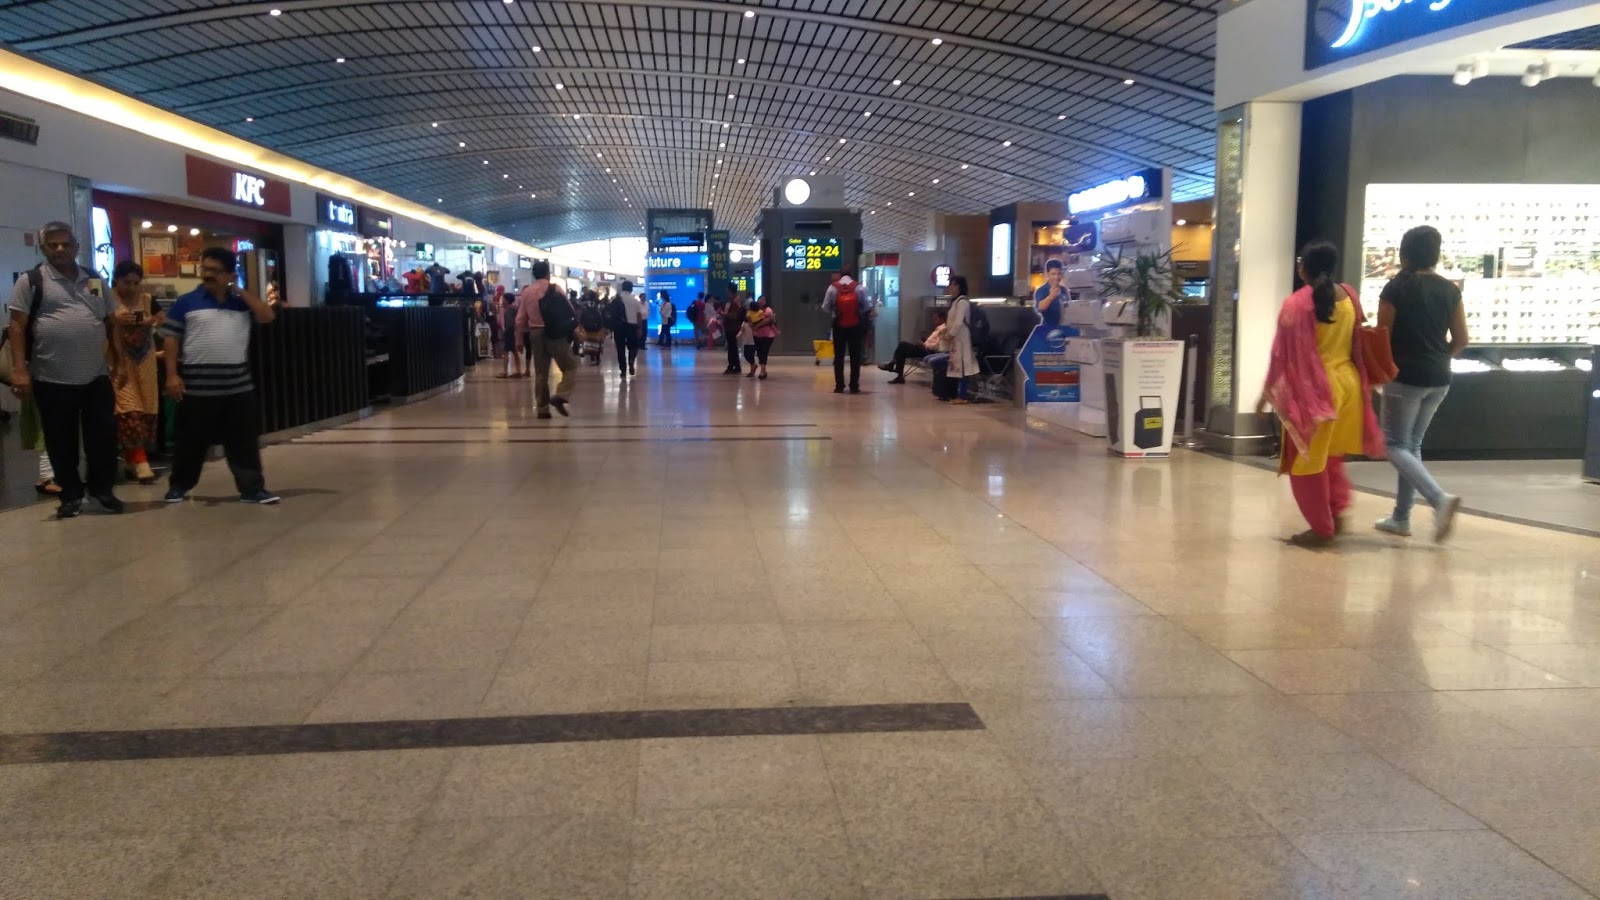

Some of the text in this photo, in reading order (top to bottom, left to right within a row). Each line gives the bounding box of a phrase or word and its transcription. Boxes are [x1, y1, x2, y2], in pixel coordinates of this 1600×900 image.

[234, 172, 265, 206] KFC
[711, 252, 727, 261] 101
[806, 245, 839, 257] 22-24
[649, 256, 681, 268] future
[806, 257, 821, 269] 26
[711, 270, 727, 279] 112
